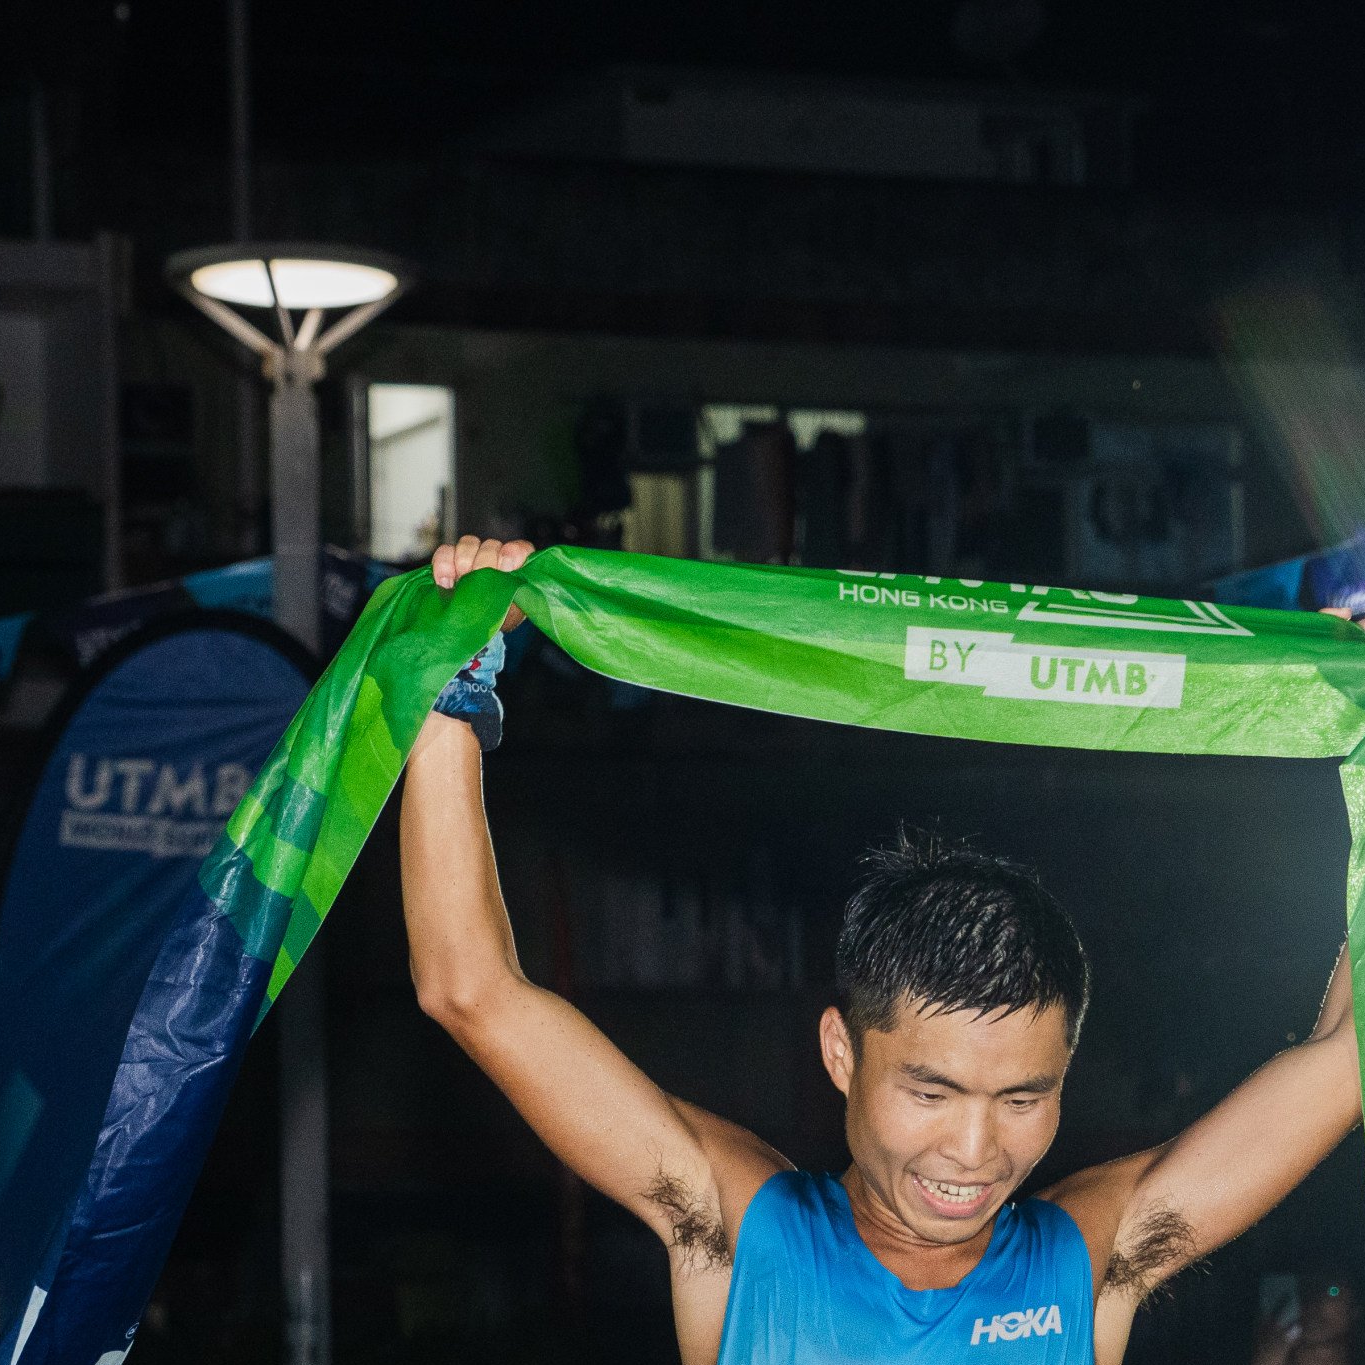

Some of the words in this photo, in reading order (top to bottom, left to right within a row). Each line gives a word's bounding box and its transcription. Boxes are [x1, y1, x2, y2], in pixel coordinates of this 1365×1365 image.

[838, 582, 921, 607] HONG
[930, 594, 1010, 614] KONG
[929, 639, 976, 674] BY
[1030, 655, 1149, 697] UTMB
[65, 752, 254, 817] UTMB
[970, 1304, 1063, 1346] HOKA
